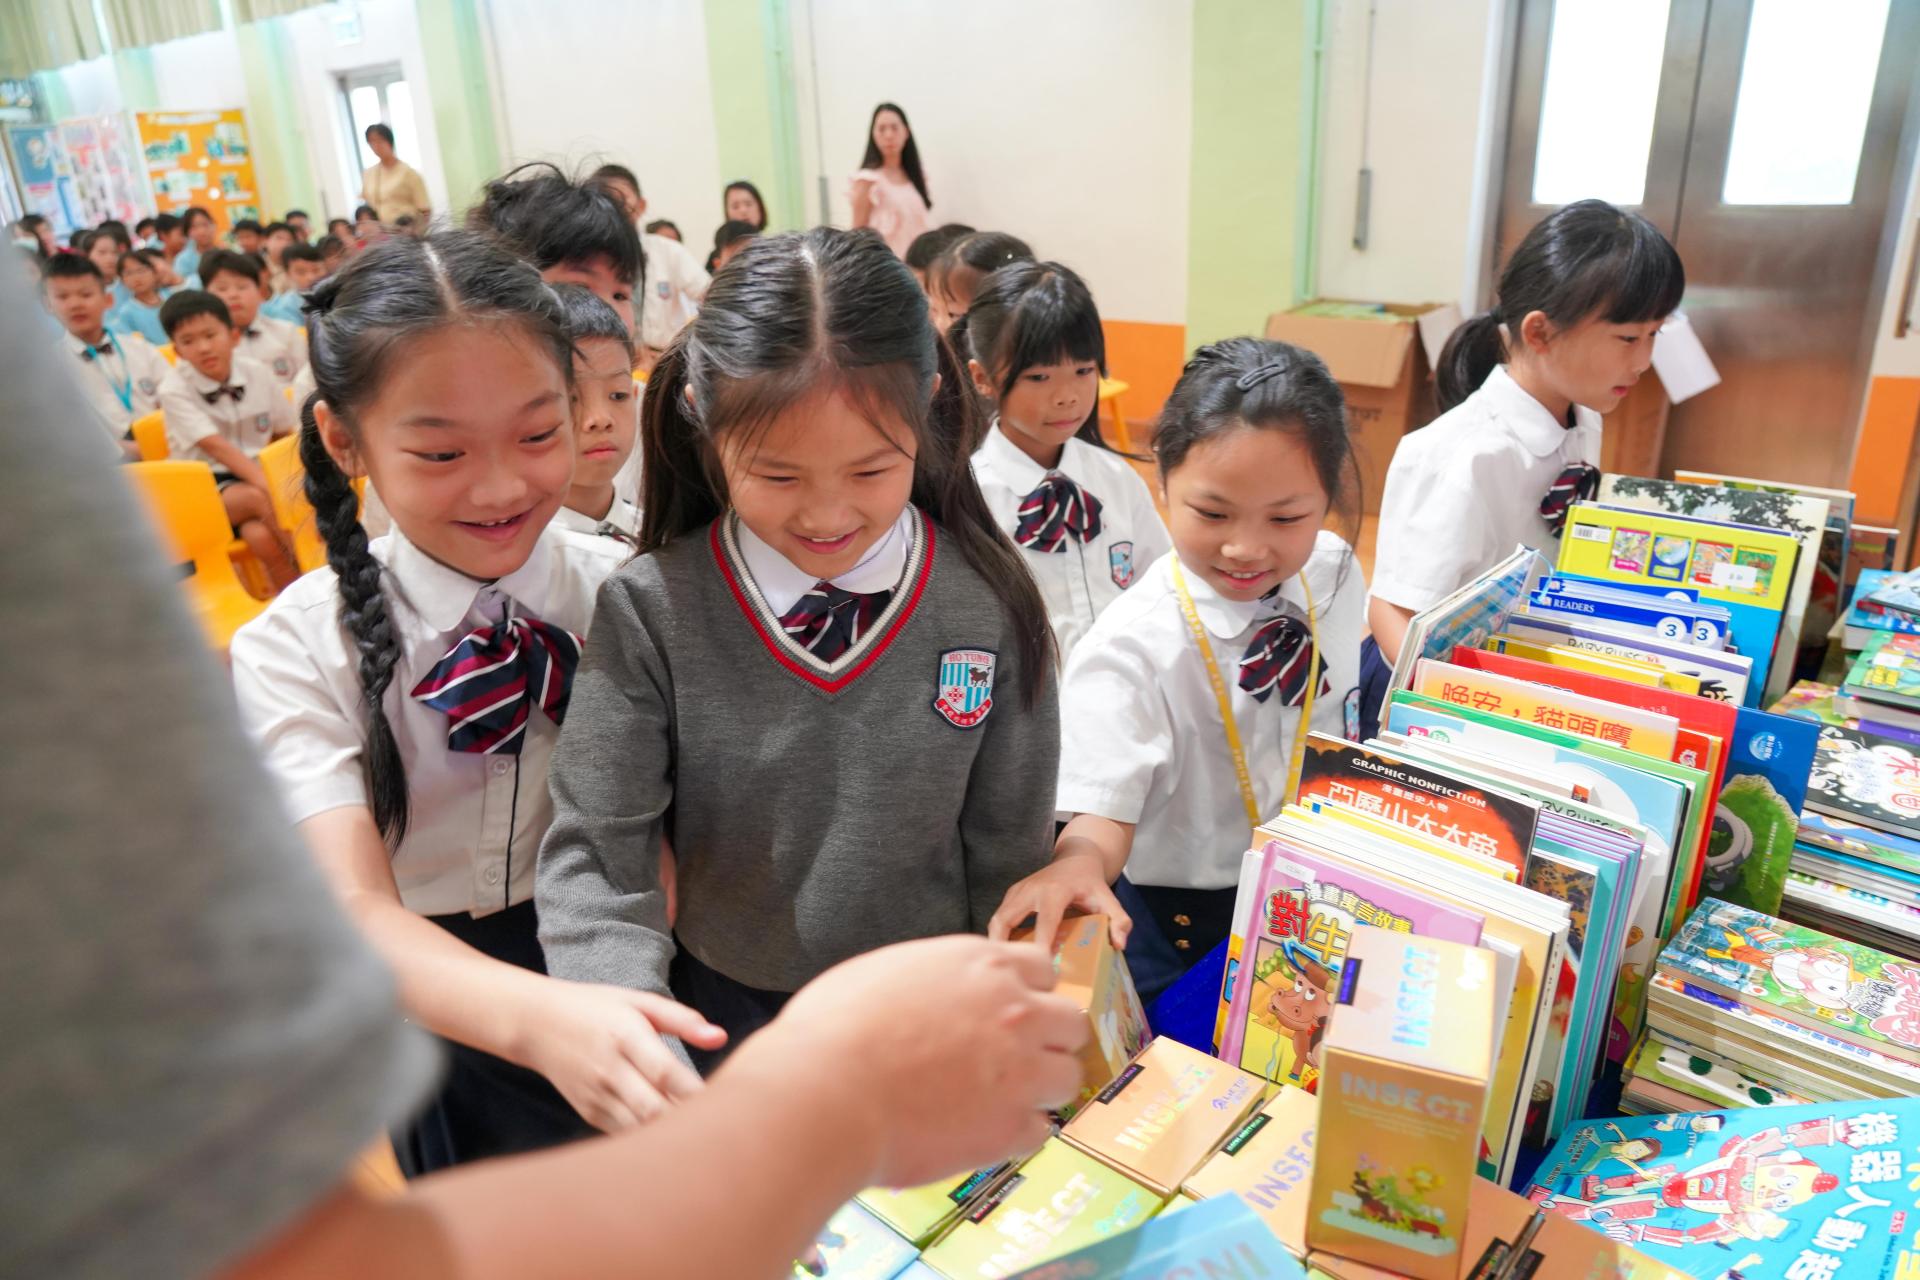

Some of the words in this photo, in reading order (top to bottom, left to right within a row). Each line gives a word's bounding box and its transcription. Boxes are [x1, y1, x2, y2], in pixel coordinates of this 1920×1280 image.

[1553, 598, 1596, 614] READERS
[1664, 623, 1677, 638] 3
[1696, 627, 1709, 642] 3
[1441, 682, 1634, 750] 晚安，貓頭鷹
[1352, 757, 1406, 782] GRAPHIC
[1407, 776, 1487, 809] NONFICTION
[1392, 946, 1440, 1048] INSECT
[1114, 1063, 1215, 1150] INSECT
[1340, 1071, 1474, 1124] INSECT
[1245, 1129, 1314, 1209] INSEC
